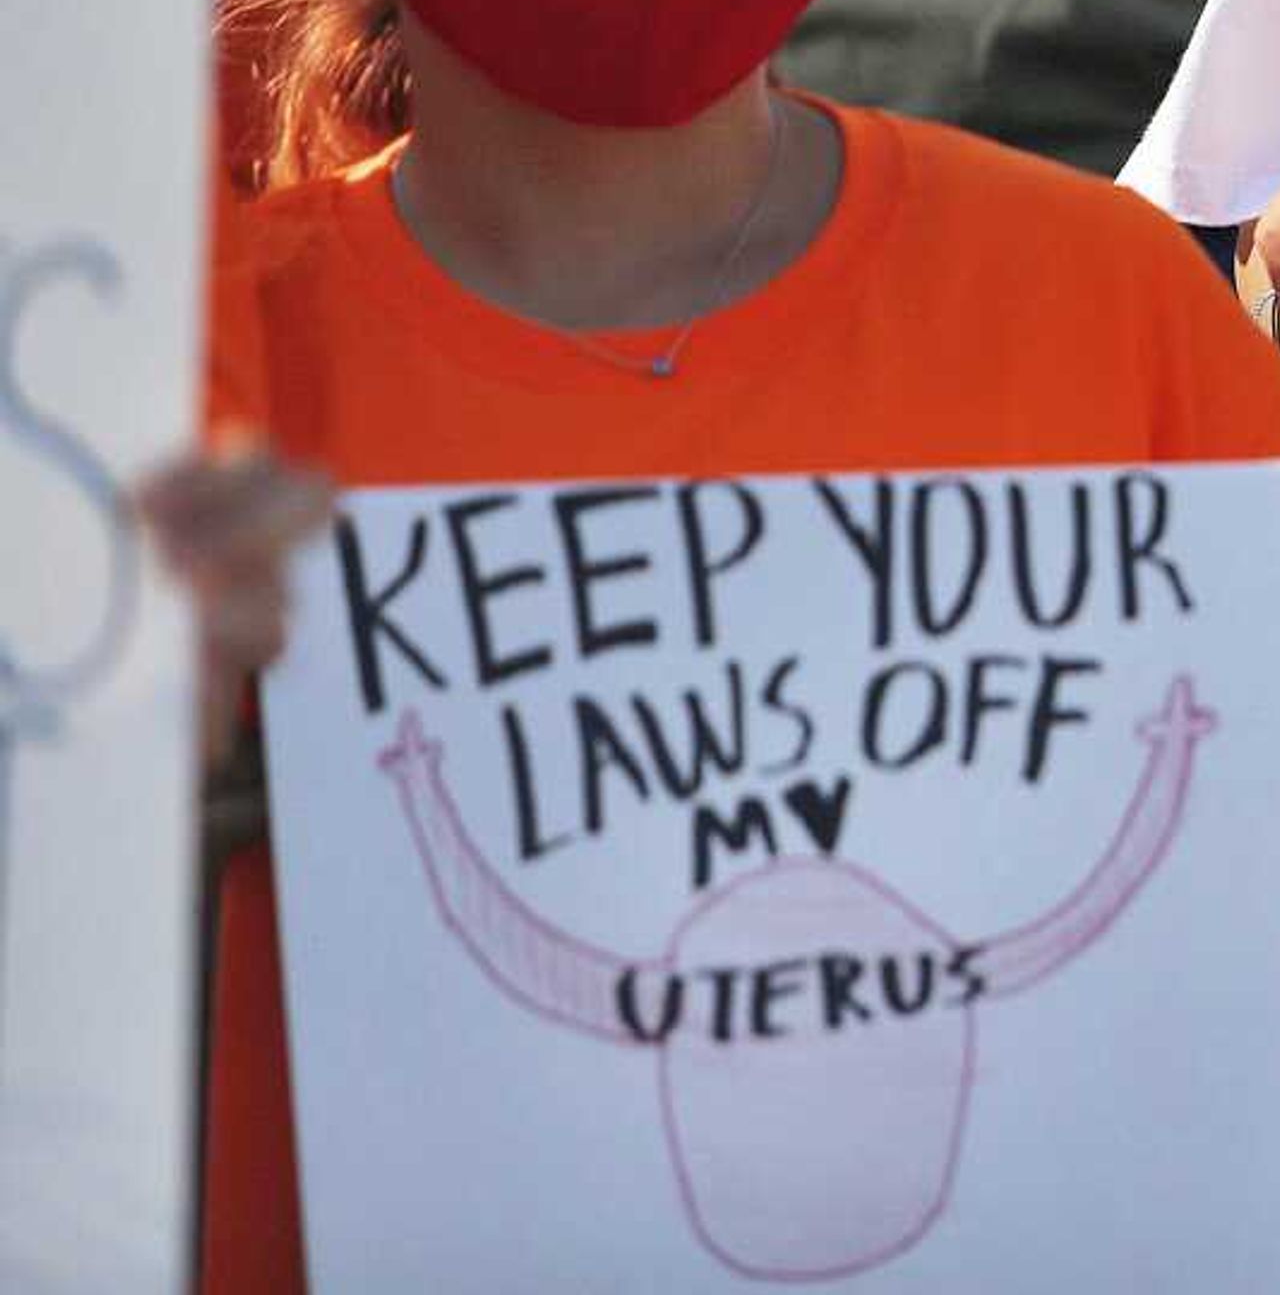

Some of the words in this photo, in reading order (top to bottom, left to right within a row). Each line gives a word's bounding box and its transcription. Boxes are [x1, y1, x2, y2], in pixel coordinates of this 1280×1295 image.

[334, 479, 766, 714] KEEP
[810, 473, 1194, 649] YOUR
[500, 655, 818, 861] LAWS
[860, 656, 1103, 783] OFF
[614, 945, 987, 1043] UTERUS
